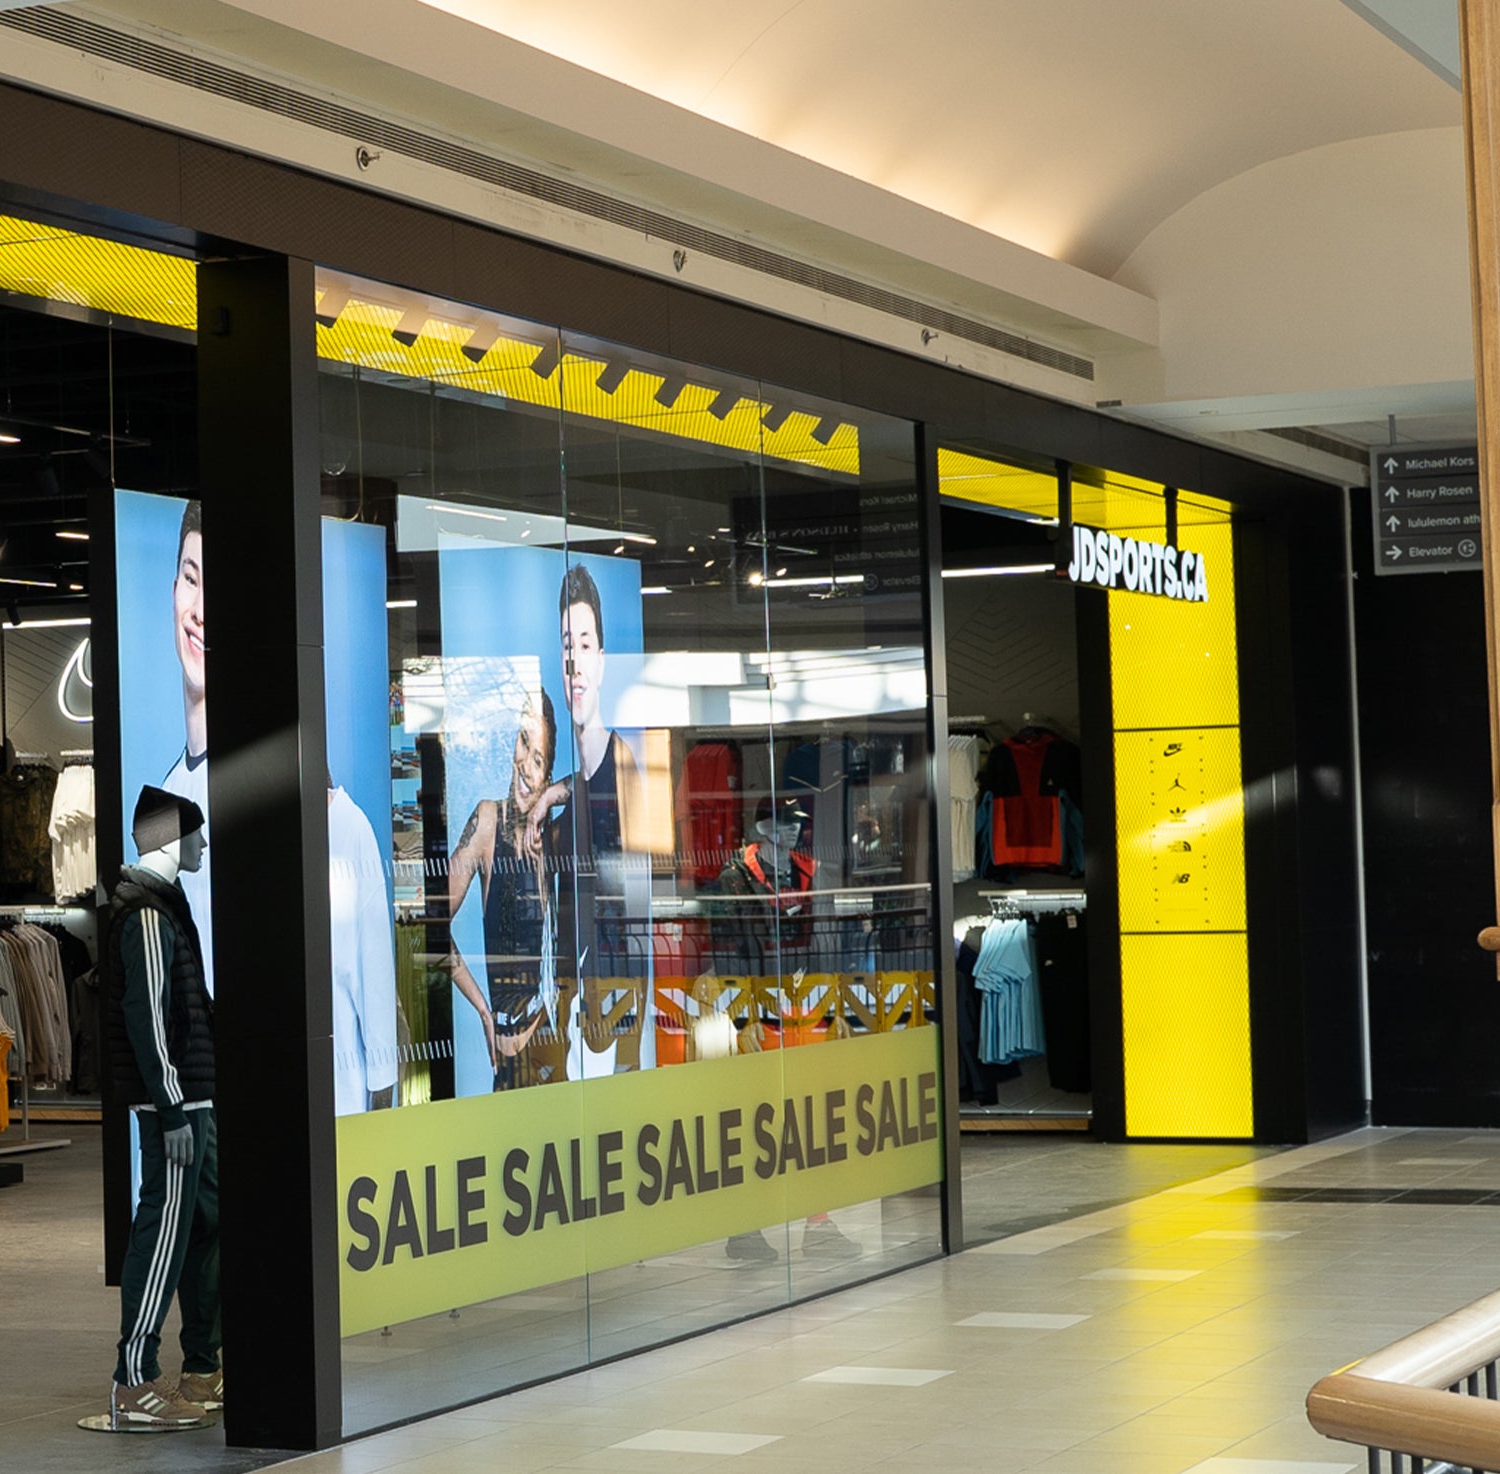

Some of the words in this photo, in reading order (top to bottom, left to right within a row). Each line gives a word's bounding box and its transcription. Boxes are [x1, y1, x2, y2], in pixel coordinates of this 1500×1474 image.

[1405, 458, 1448, 470] Michael
[1449, 456, 1475, 467] Kors
[1406, 487, 1437, 499] Harry
[1438, 485, 1473, 496] Rosen
[1407, 516, 1461, 528] lululemon
[1408, 546, 1454, 557] Elevator
[1068, 525, 1209, 602] JDSPORTS.CA
[346, 1155, 488, 1272] SALE
[502, 1131, 625, 1236] SALE
[637, 1108, 744, 1206] SALE
[753, 1089, 848, 1180] SALE
[855, 1072, 938, 1156] SALE
